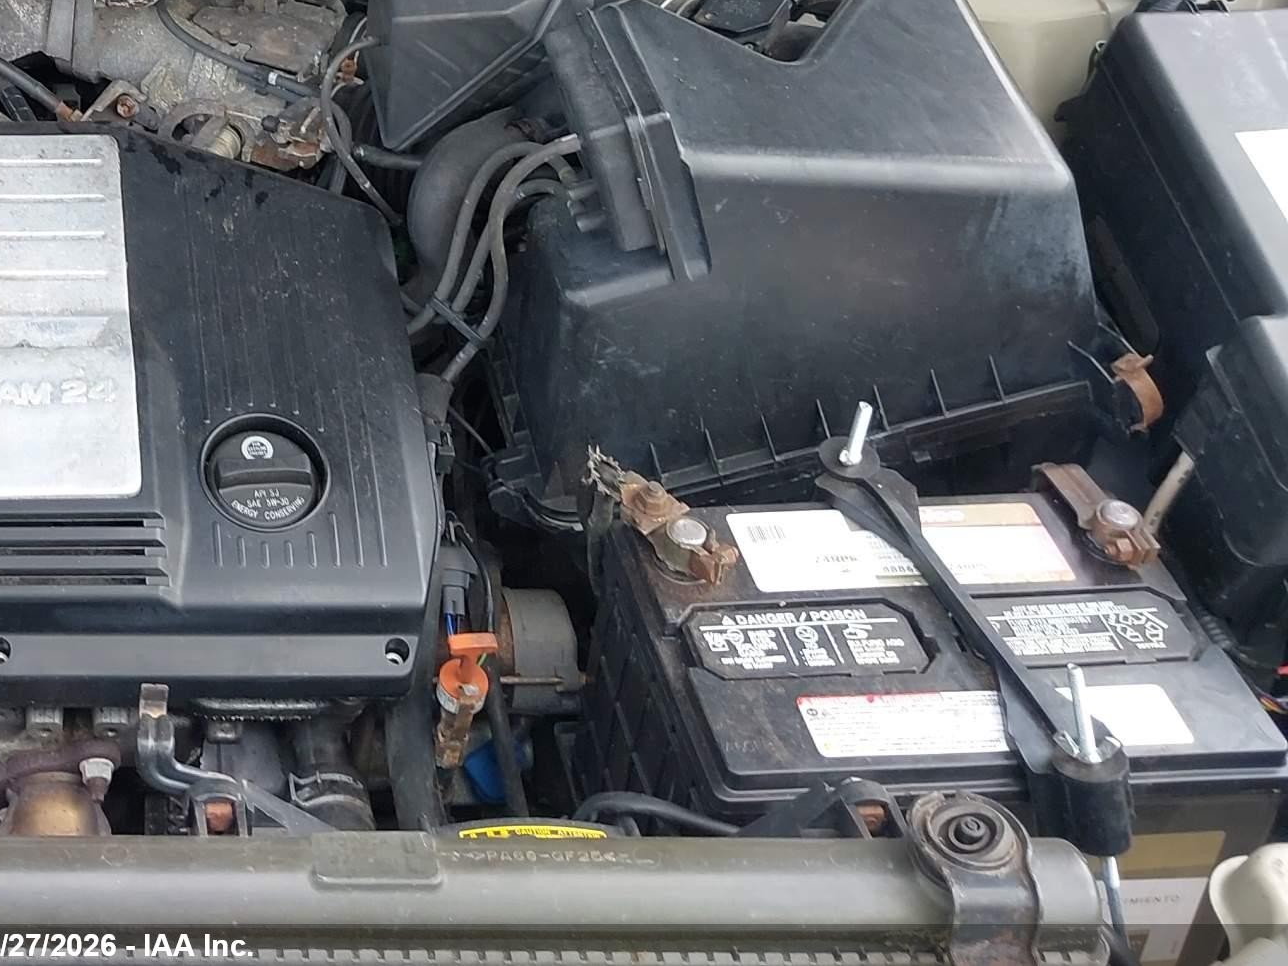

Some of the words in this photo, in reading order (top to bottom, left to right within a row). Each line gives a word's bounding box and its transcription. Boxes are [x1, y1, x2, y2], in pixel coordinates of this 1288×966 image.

[254, 489, 267, 498] API
[231, 499, 259, 518] ENERGY
[264, 495, 305, 520] CONSERVING
[246, 499, 262, 508] SAE
[266, 497, 290, 508] 5W-30
[735, 612, 795, 626] DANGER
[810, 609, 868, 621] POISON
